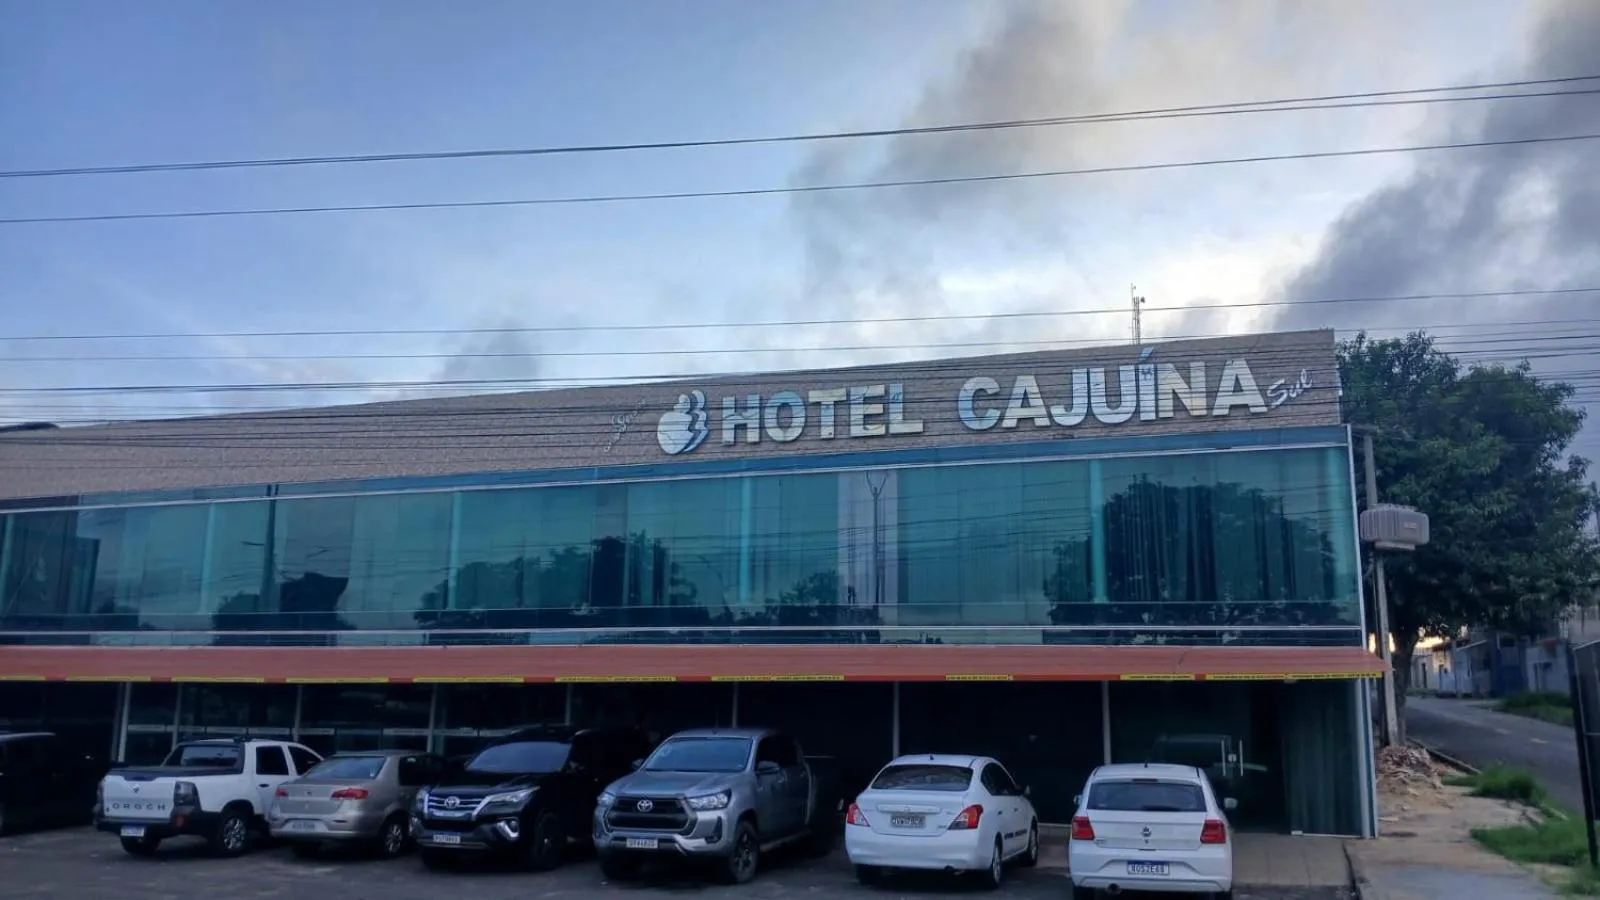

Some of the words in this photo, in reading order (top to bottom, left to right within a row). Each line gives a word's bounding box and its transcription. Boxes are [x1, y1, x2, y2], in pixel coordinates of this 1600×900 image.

[722, 384, 924, 446] HOTEL
[957, 347, 1268, 430] CAJUÍNA
[1267, 369, 1312, 408] Sul
[112, 803, 165, 811] OROCH
